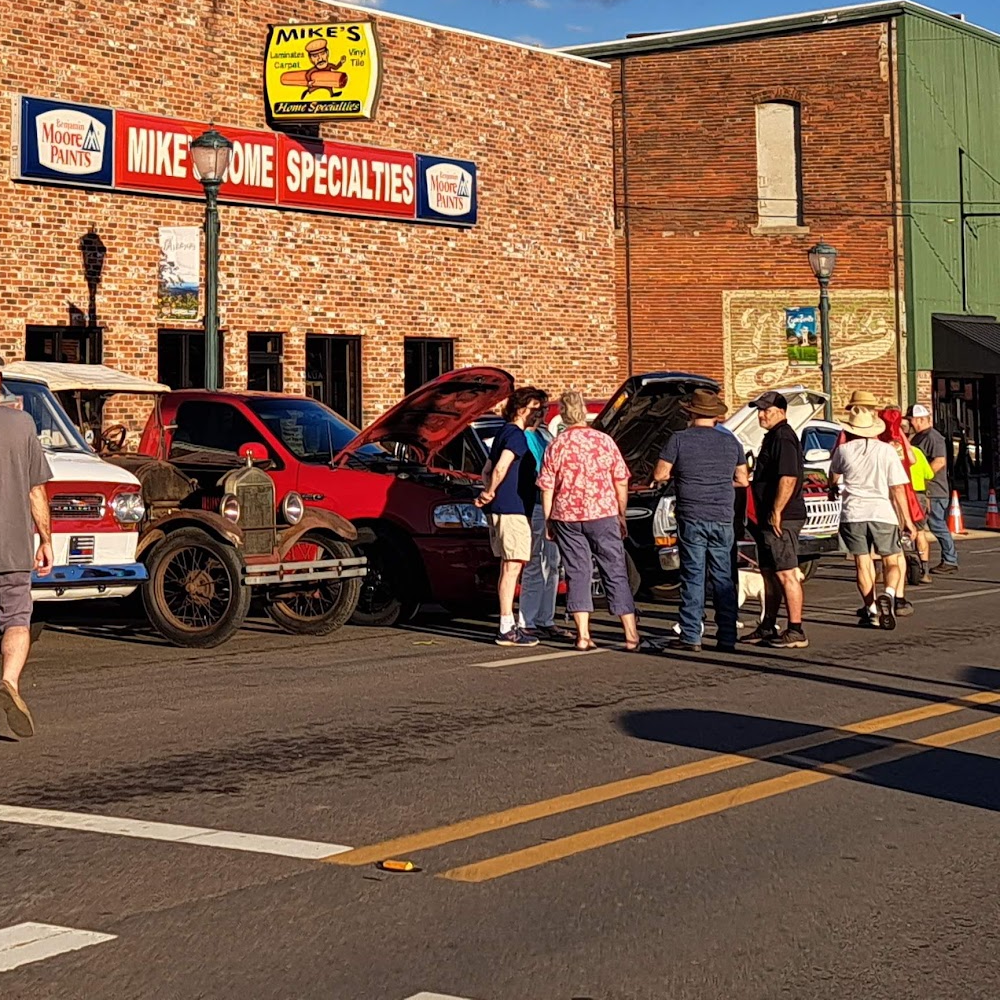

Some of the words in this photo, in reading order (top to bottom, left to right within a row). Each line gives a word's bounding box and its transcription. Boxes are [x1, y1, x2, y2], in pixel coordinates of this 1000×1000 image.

[276, 26, 361, 46] MIKE'S
[270, 51, 305, 59] Laminates
[348, 48, 366, 58] Vinyl
[274, 61, 301, 70] Carpet
[350, 58, 365, 67] Tile
[276, 102, 306, 113] Home
[307, 100, 360, 114] Specialties
[56, 118, 85, 130] Benjamin
[41, 122, 83, 148] Moore
[50, 145, 92, 168] PAINTS
[128, 127, 202, 182] MIKE'
[222, 140, 274, 188] OME
[286, 149, 414, 205] SPECIALTIES
[431, 174, 457, 194] Moore
[436, 192, 464, 211] PAINTS
